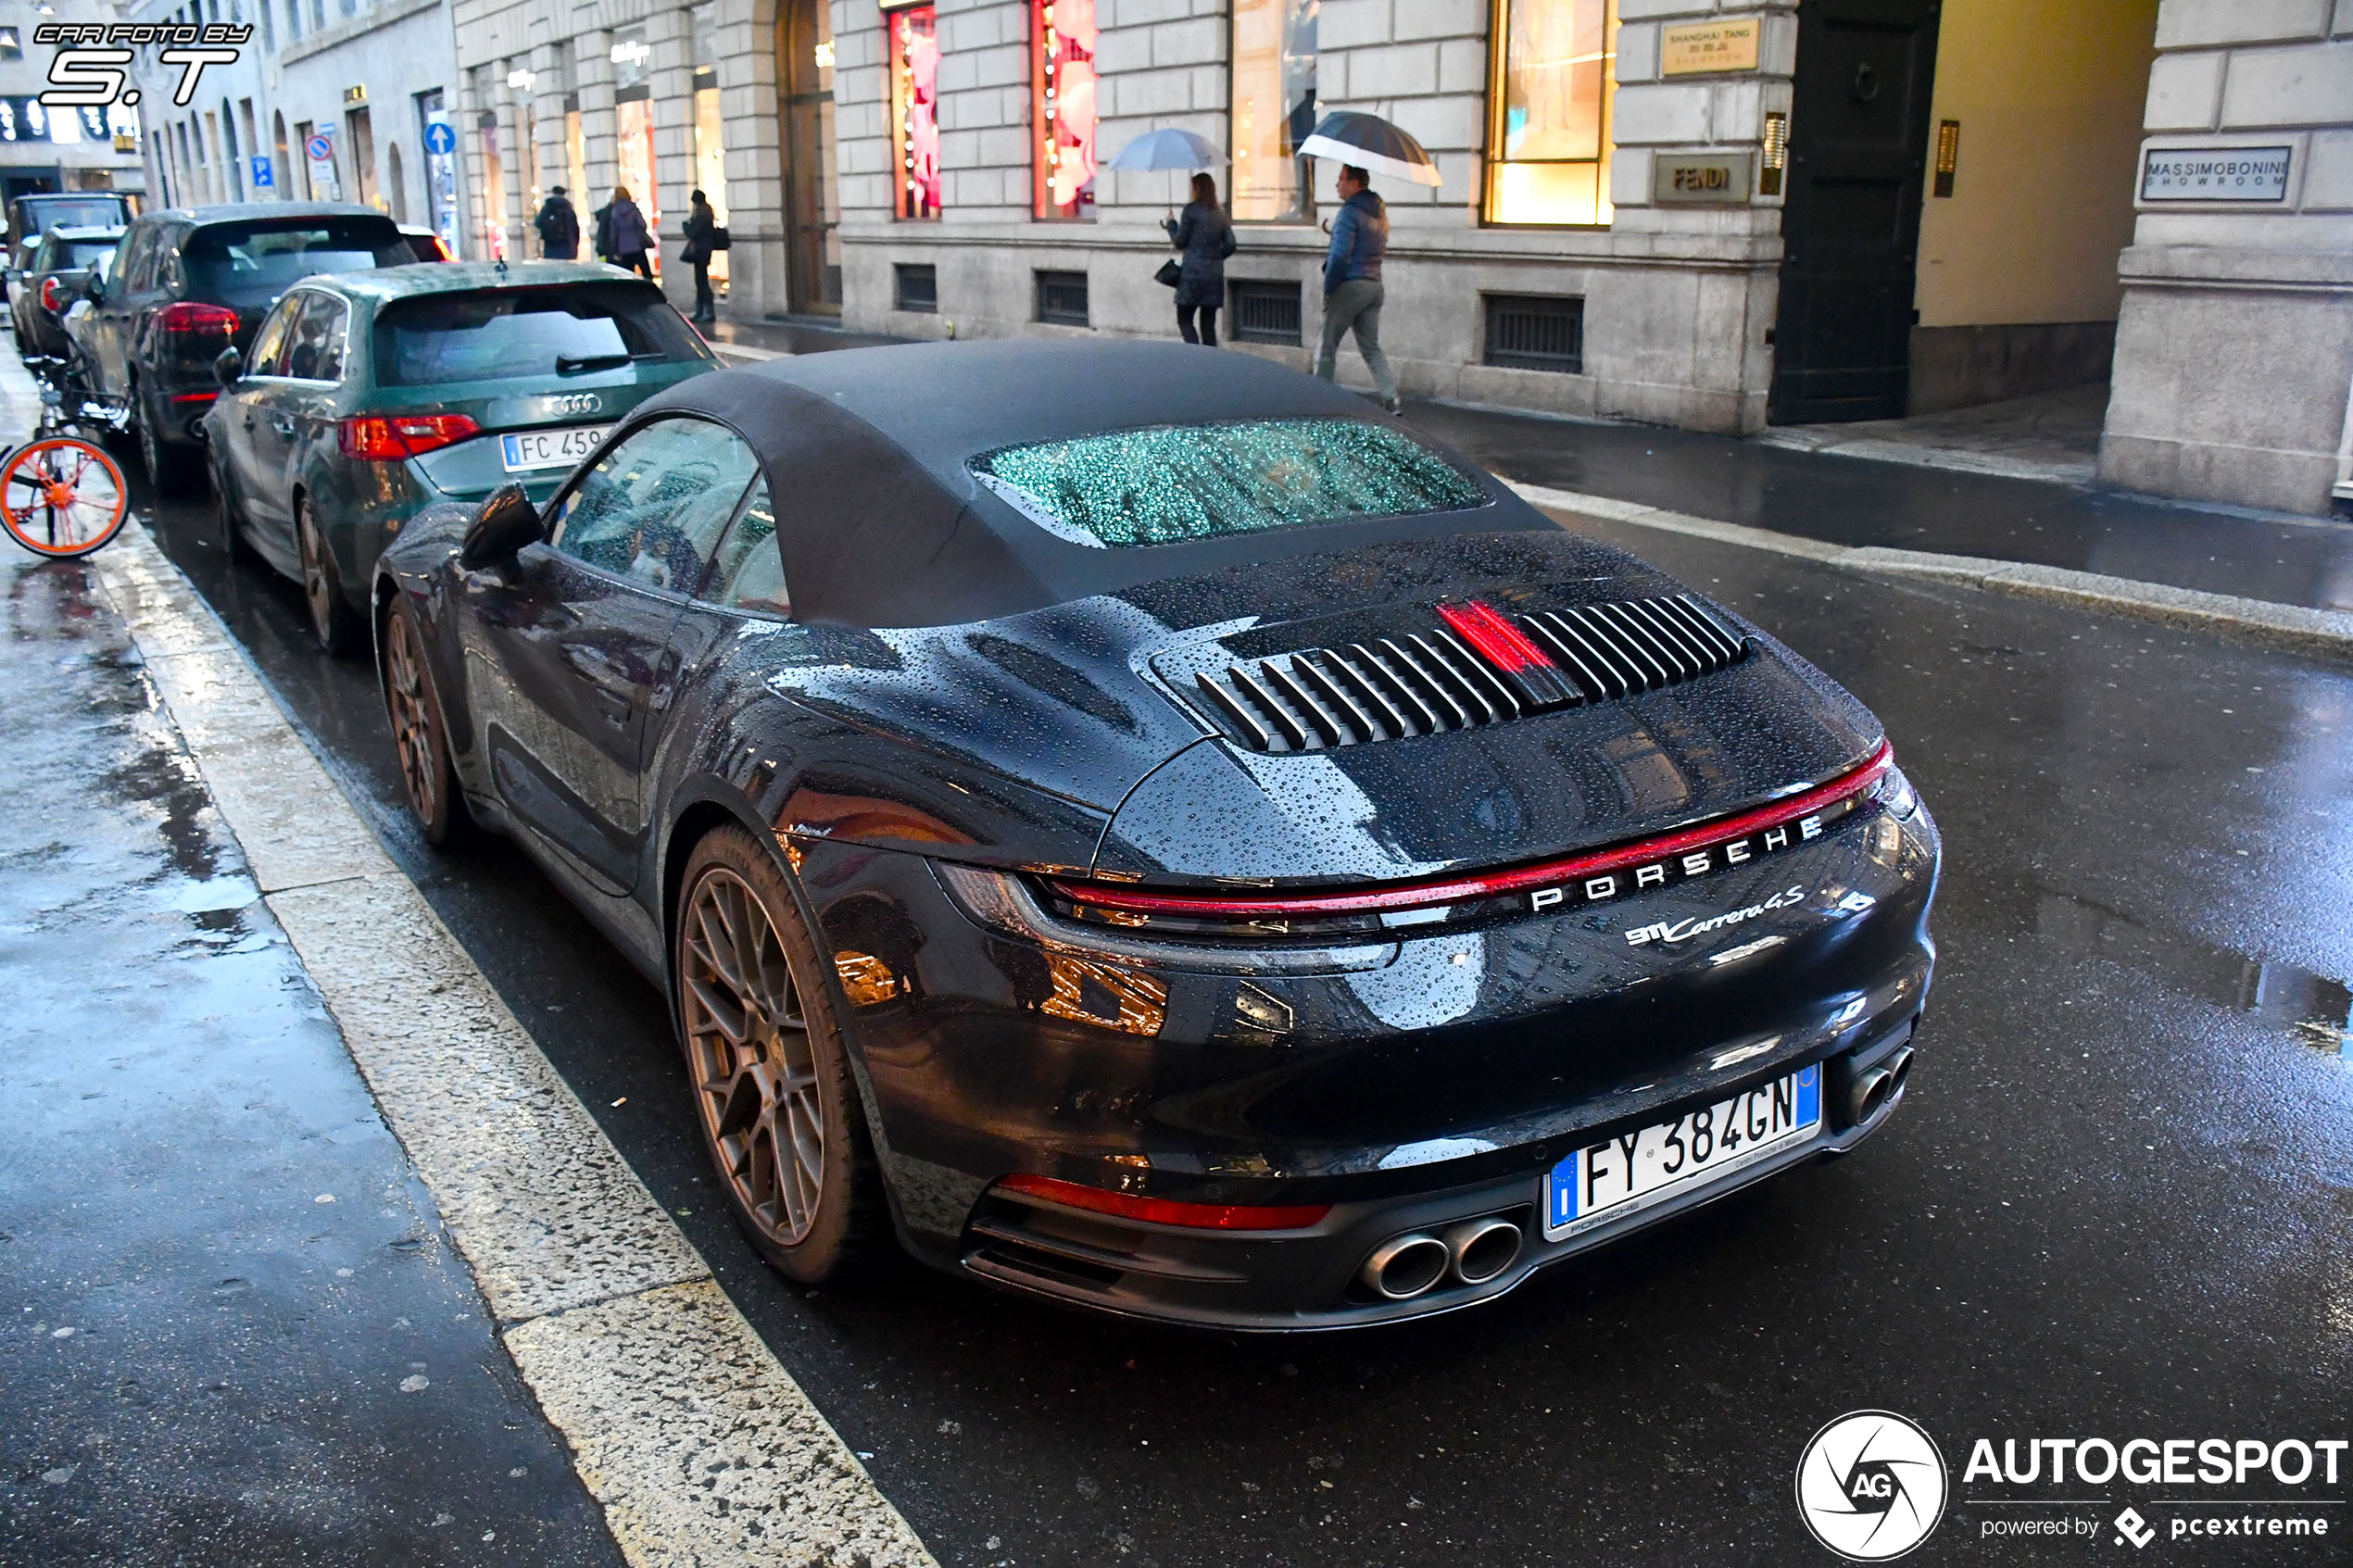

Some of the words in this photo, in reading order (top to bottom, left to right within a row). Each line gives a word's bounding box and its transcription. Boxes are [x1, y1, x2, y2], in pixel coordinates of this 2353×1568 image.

[1670, 31, 1720, 44] SHANGHAI
[1725, 28, 1750, 39] TANG
[1673, 168, 1730, 191] FENDI
[2148, 161, 2286, 176] MASSIMOBONINI
[2146, 176, 2285, 186] SHOWROOM
[521, 435, 550, 461] FC
[1531, 815, 1822, 911] PORSCHE
[1587, 1131, 1642, 1208] FY
[1663, 1075, 1793, 1174] 384GN
[1571, 1201, 1640, 1234] PORSCHE
